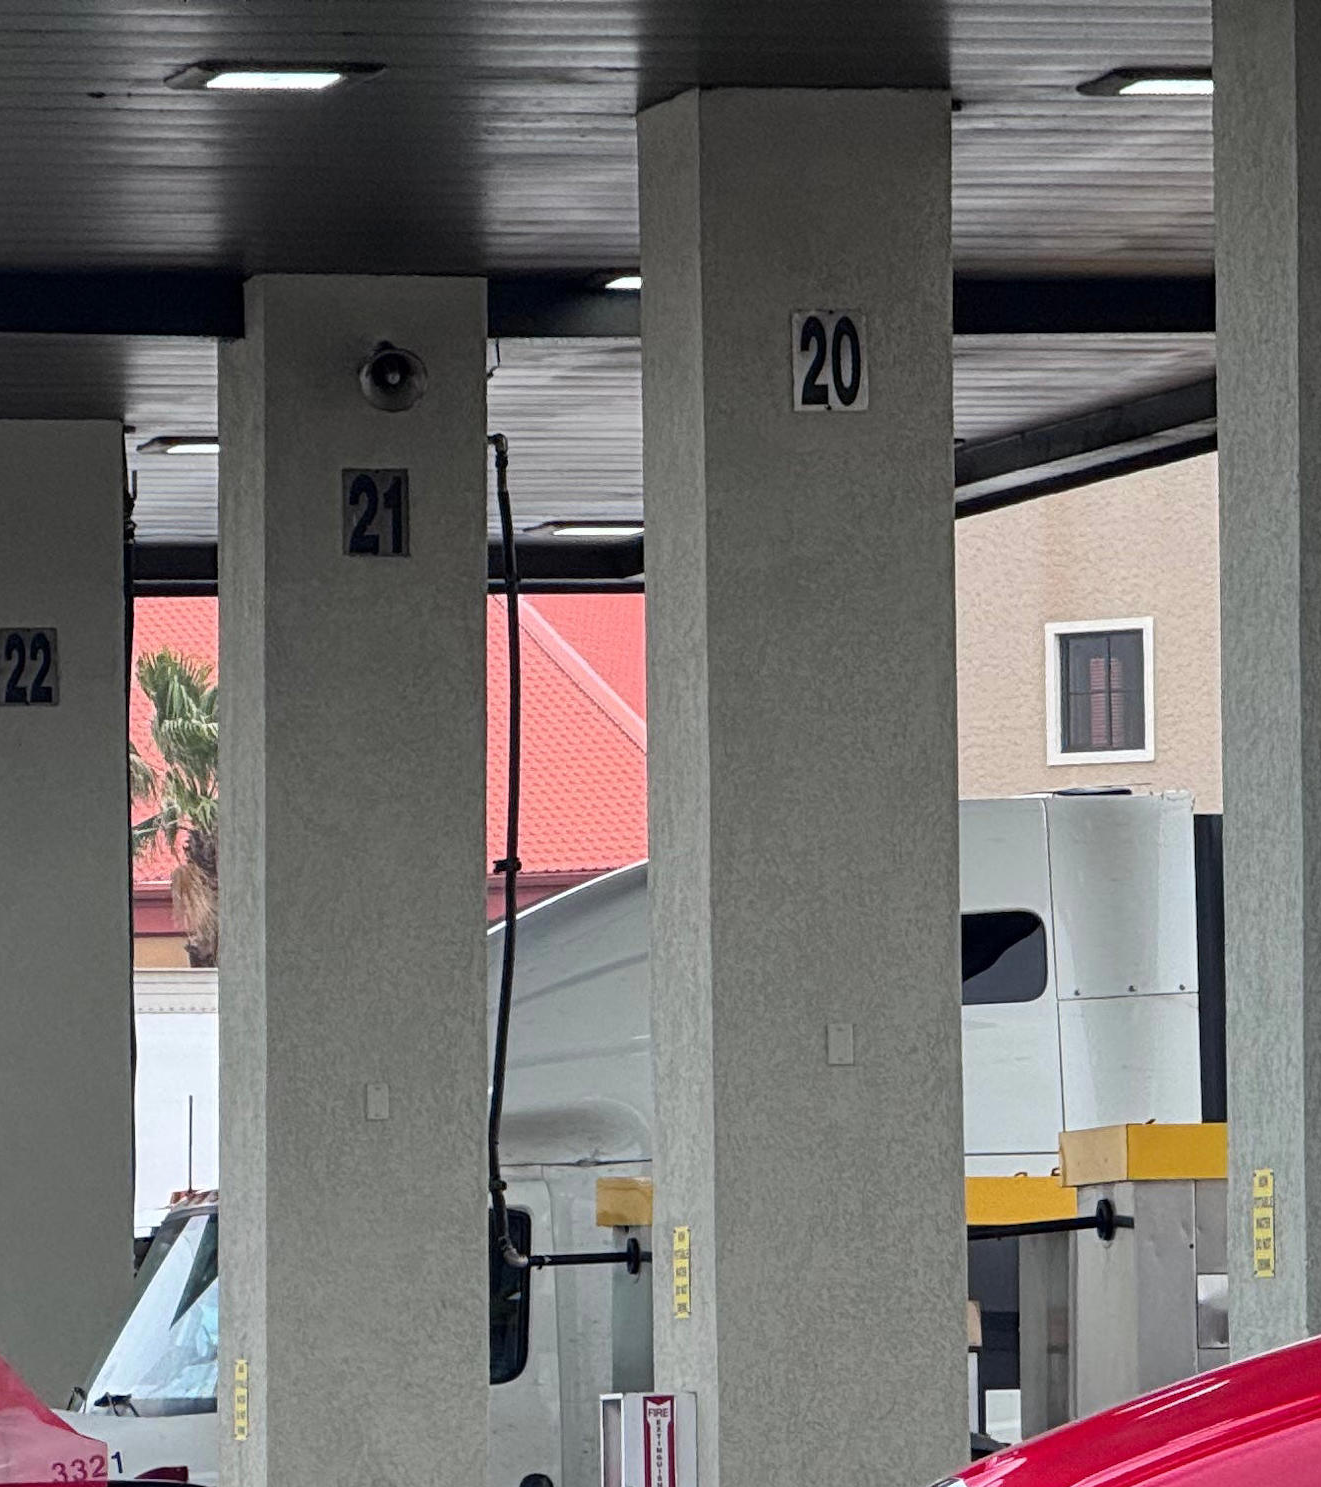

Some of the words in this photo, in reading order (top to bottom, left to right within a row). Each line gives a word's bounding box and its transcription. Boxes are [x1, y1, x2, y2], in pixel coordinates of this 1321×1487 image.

[800, 316, 861, 407] 20
[349, 474, 403, 554] 21
[5, 633, 53, 703] 22
[648, 1407, 669, 1418] FIRE
[52, 1450, 123, 1482] 3321
